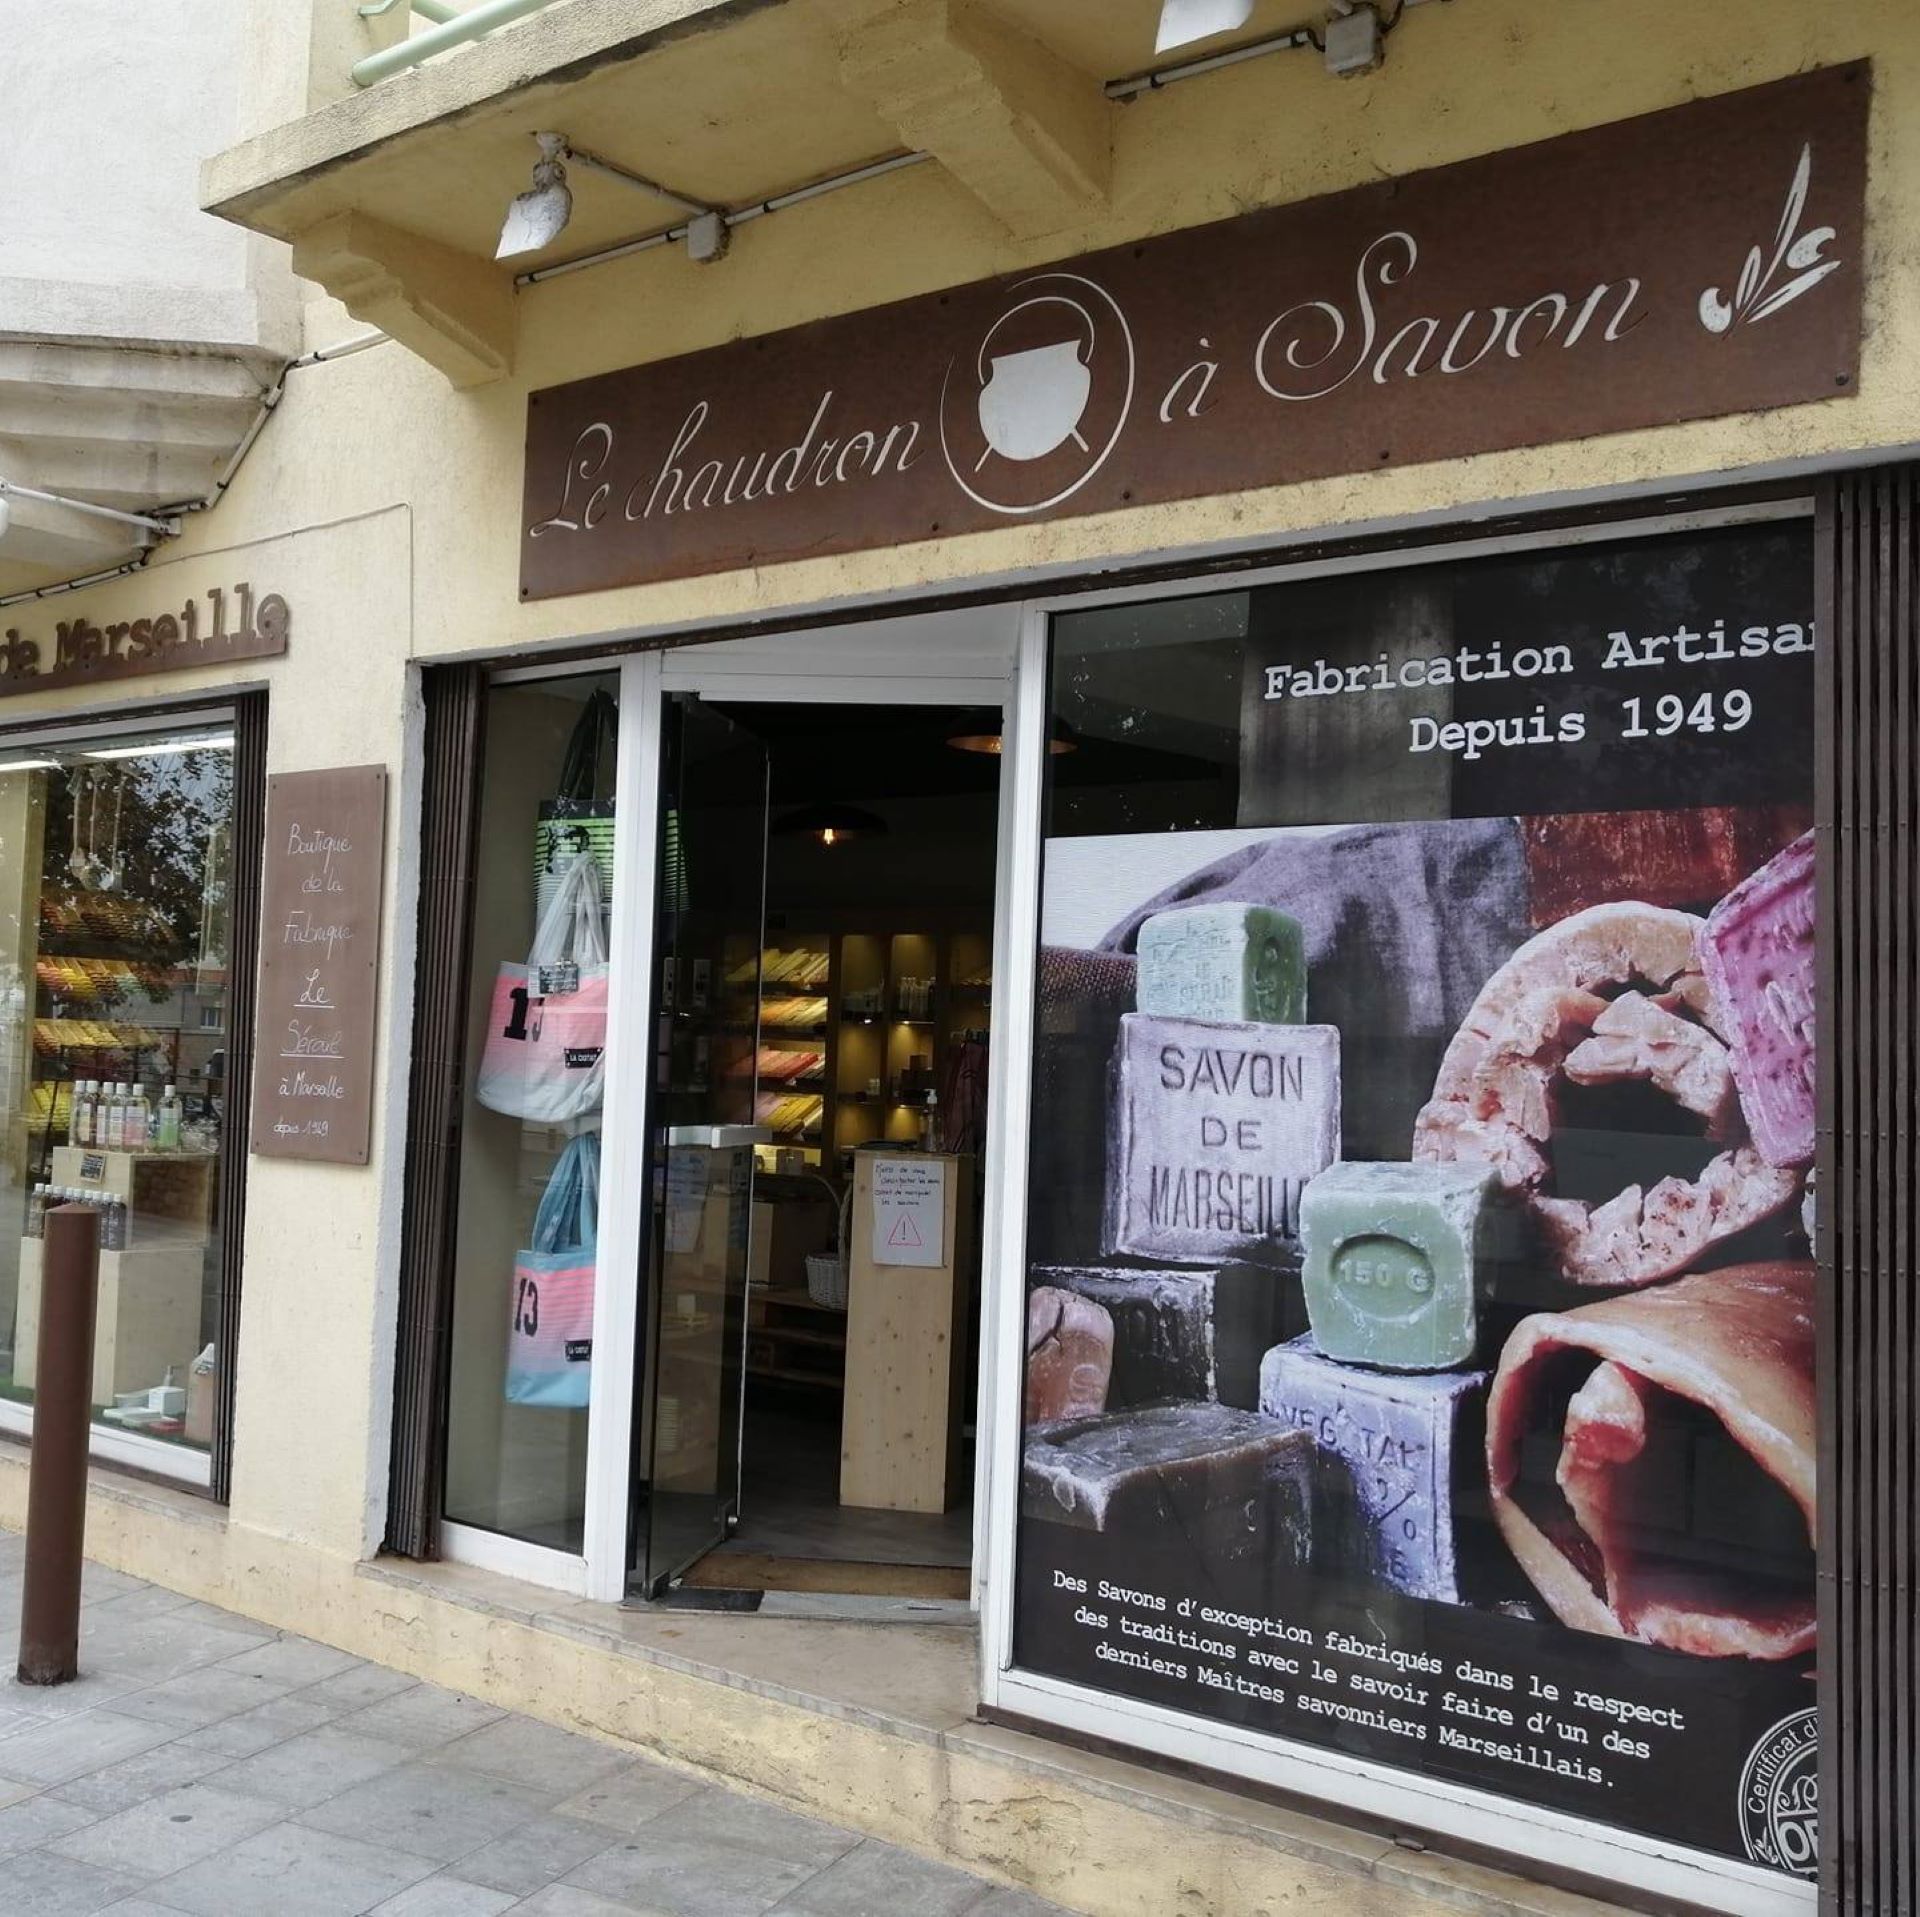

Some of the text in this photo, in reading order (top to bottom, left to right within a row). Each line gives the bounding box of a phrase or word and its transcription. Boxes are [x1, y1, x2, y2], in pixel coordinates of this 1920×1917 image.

[529, 230, 1649, 539] Le chaudron à Savon
[53, 580, 289, 673] Marseille
[1263, 640, 1574, 700] Fabrication
[1409, 689, 1753, 761] Depuis 1949
[287, 822, 353, 874] Boutique
[326, 865, 344, 893] la
[284, 910, 353, 961] Fabrique
[299, 967, 331, 1004] Le
[1160, 1044, 1303, 1100] SAVON
[1200, 1116, 1263, 1151] DE
[1339, 1258, 1432, 1293] 150 G
[1053, 1570, 1685, 1730] Des Savons d'exception fabriqués dans le respect
[1074, 1605, 1651, 1759] des traditions avec le savoir faire d'un des
[1095, 1641, 1615, 1787] derniers Maîtres savonniers Marseillais.
[1747, 1728, 1802, 1814] Certificat
